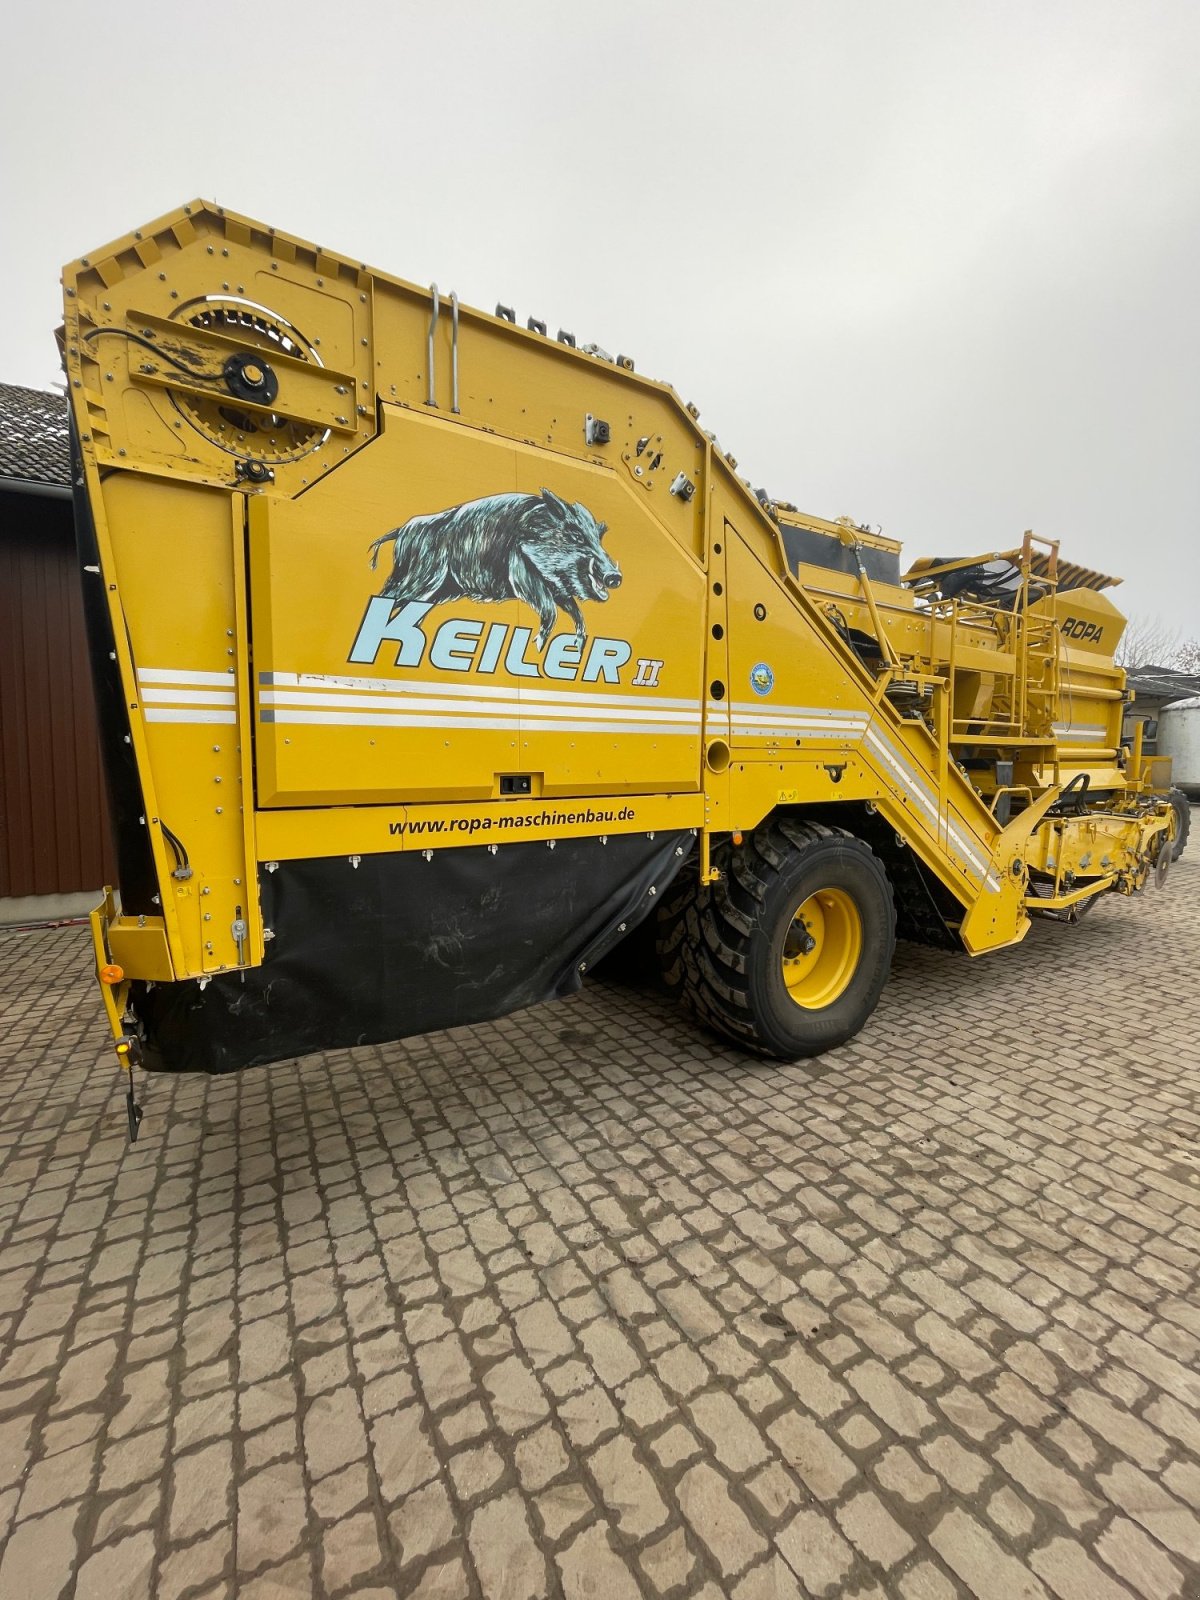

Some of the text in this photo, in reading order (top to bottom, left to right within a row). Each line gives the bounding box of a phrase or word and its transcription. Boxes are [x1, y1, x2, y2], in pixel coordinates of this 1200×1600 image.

[347, 595, 665, 687] KEILER II
[1060, 617, 1104, 644] ROPA
[388, 807, 635, 835] www.ropa-maschinenbau.de
